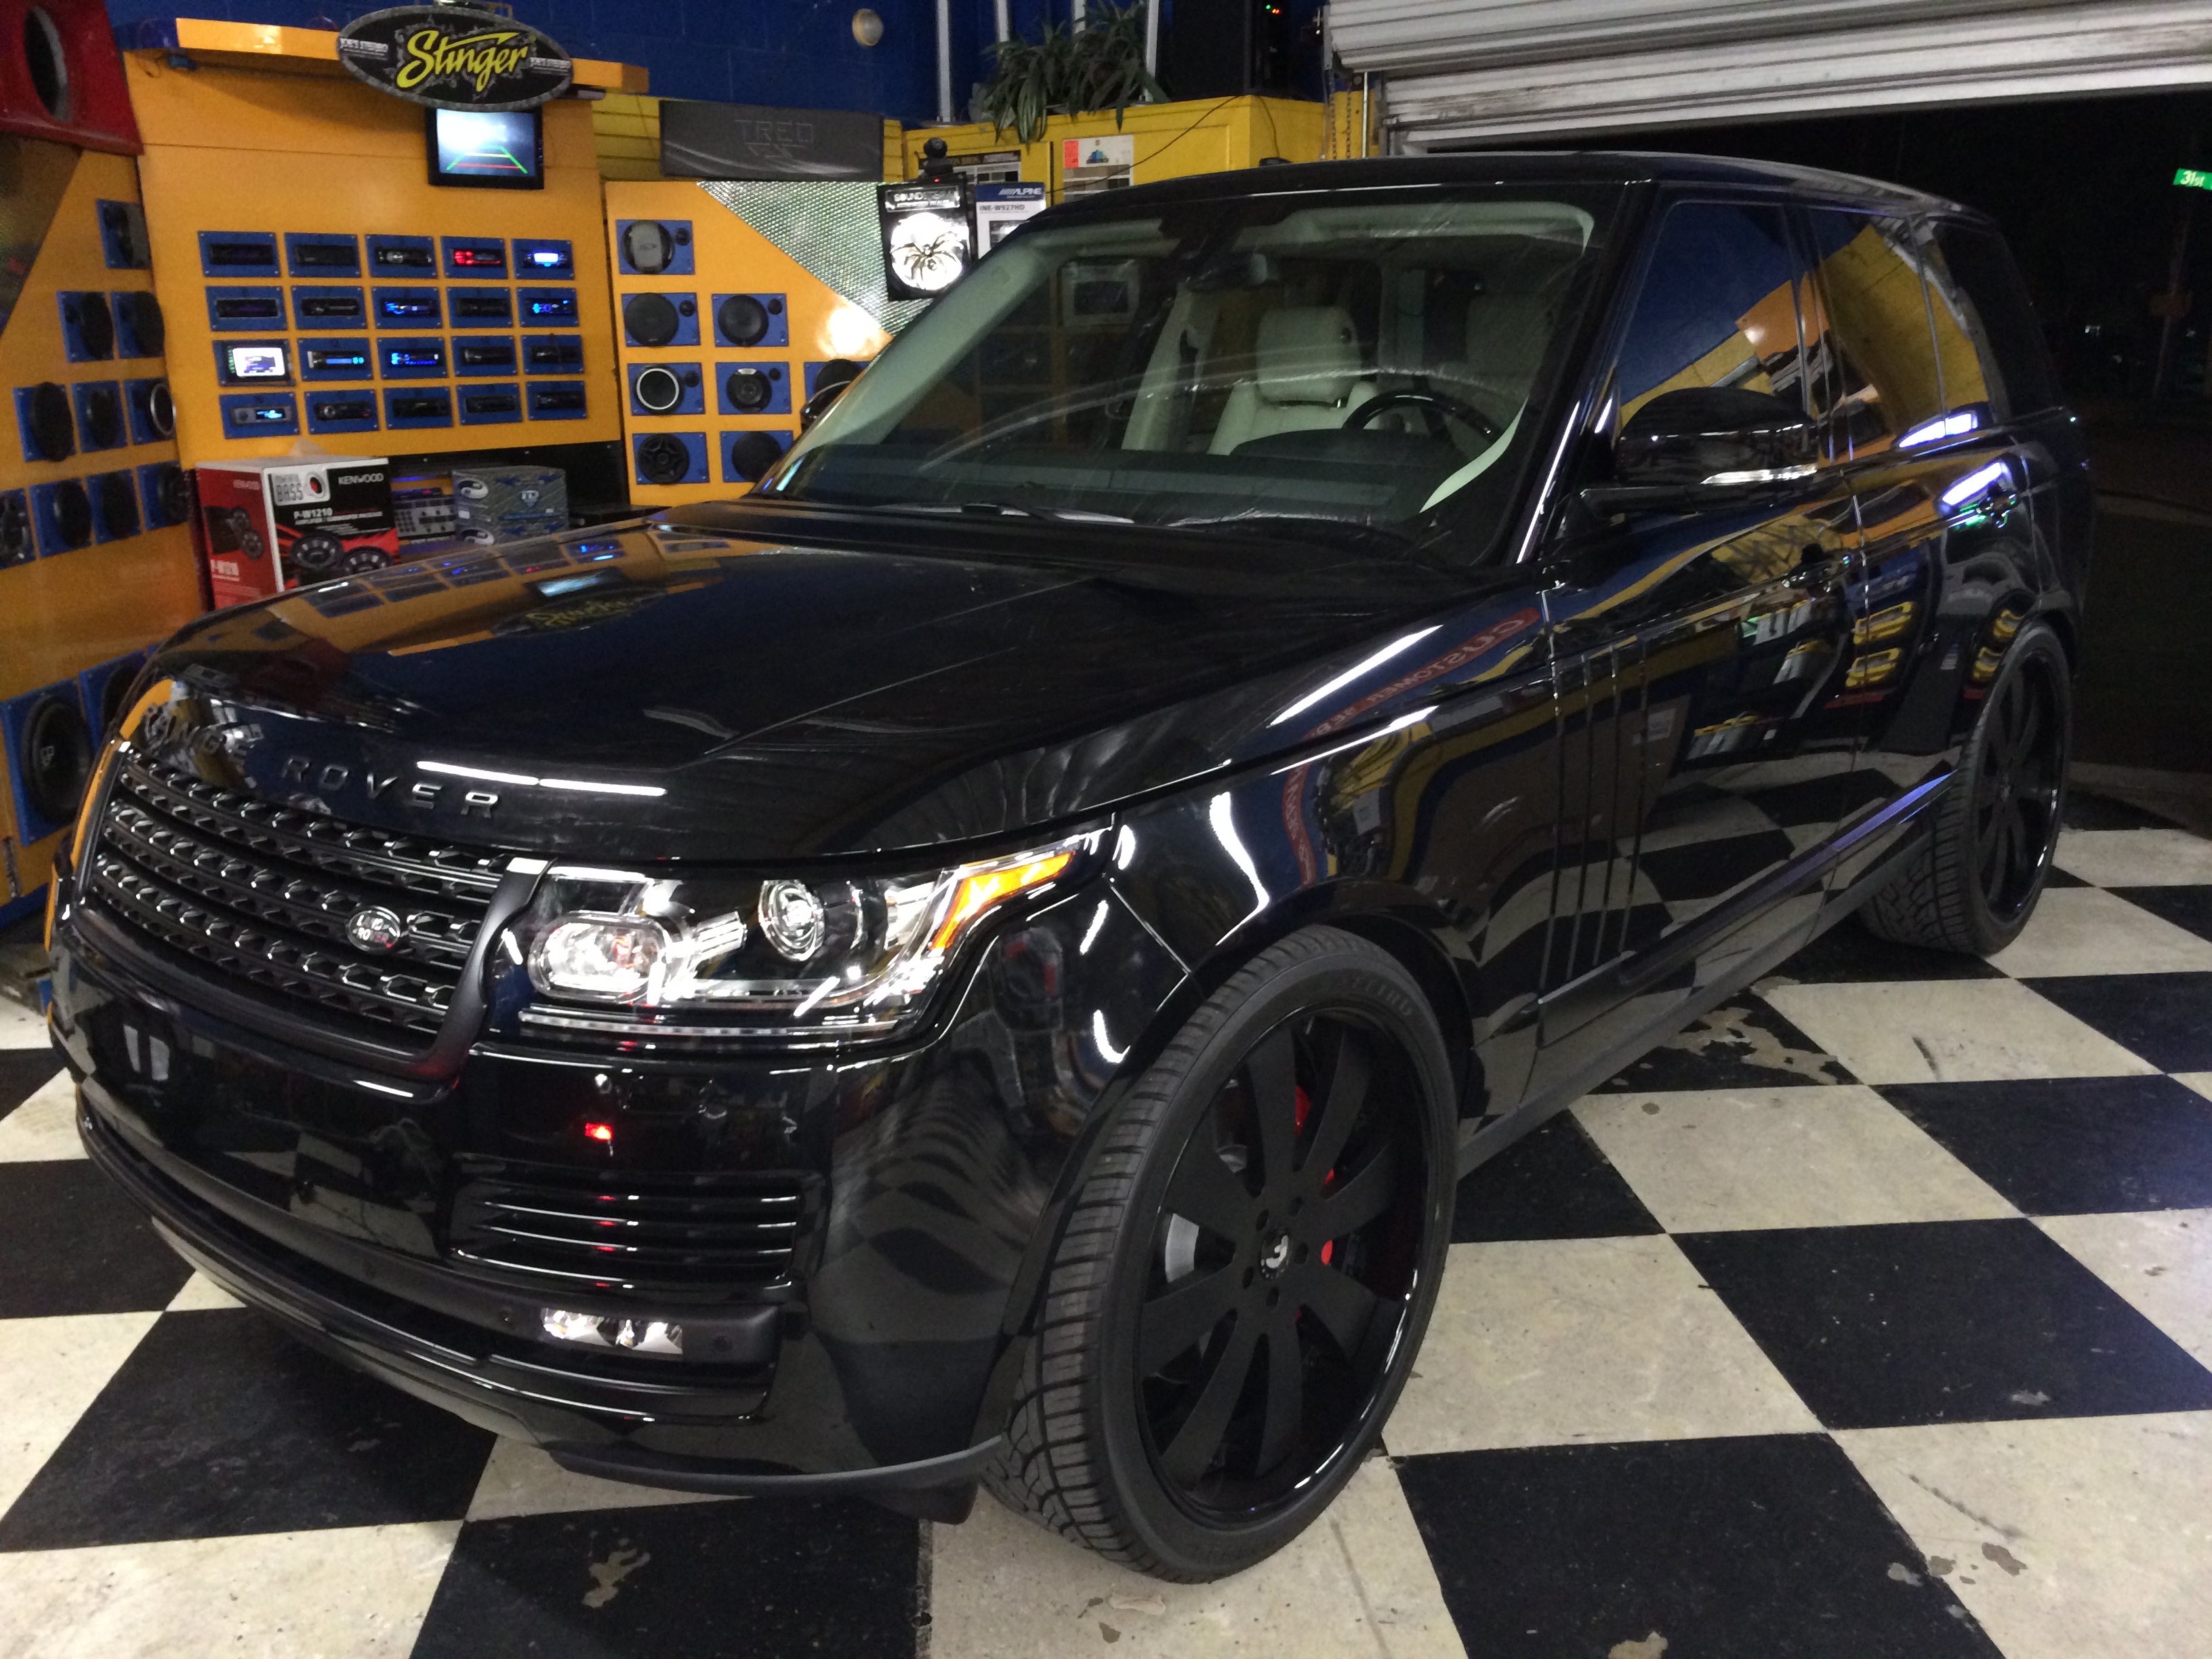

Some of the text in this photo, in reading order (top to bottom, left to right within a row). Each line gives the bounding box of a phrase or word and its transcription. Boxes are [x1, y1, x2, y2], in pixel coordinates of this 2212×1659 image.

[396, 30, 528, 92] Stinger
[1012, 187, 1042, 195] ALPINE
[338, 473, 384, 485] KENWOOD
[276, 483, 304, 502] BASS
[282, 754, 499, 819] ROVER
